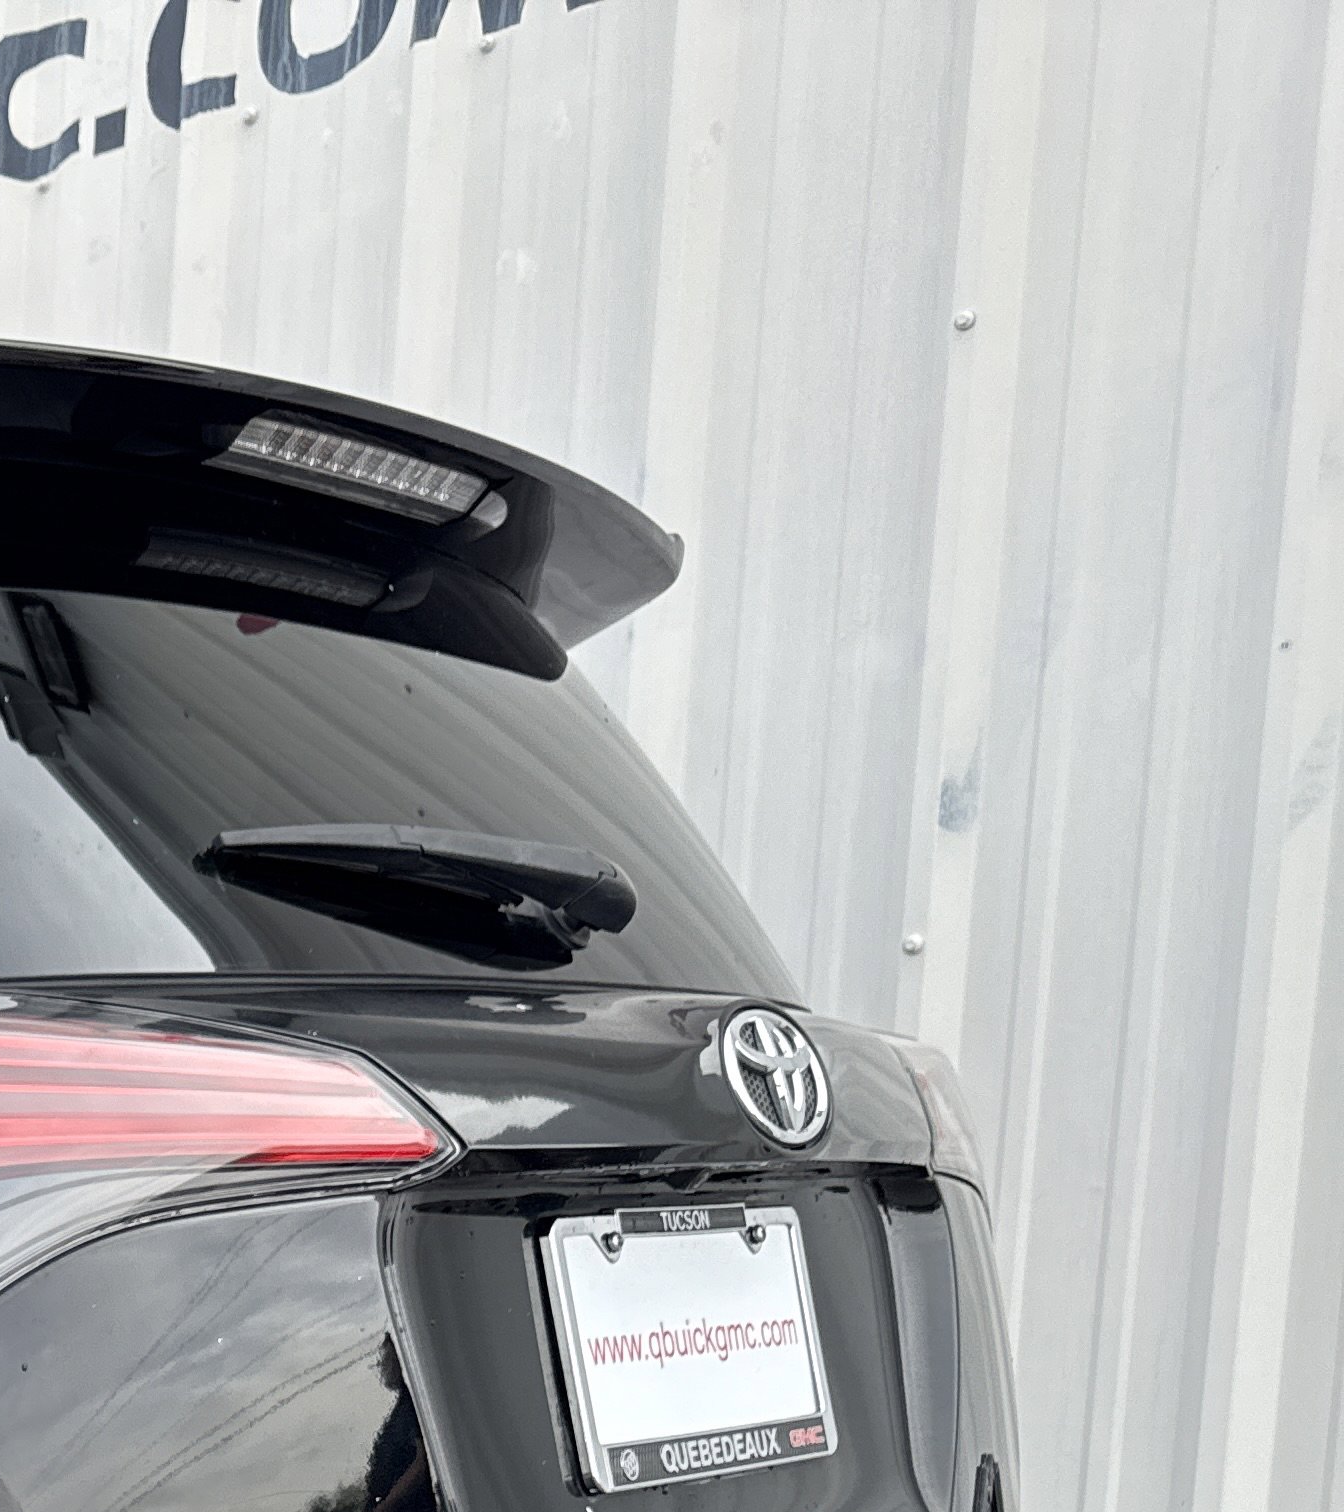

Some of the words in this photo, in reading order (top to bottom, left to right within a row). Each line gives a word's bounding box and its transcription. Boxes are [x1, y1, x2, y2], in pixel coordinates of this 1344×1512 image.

[659, 1210, 711, 1232] TUCSON
[587, 1317, 800, 1369] www.qbuickgmc.com
[661, 1427, 782, 1474] QUEBEDEAUX
[789, 1425, 825, 1449] GMC
